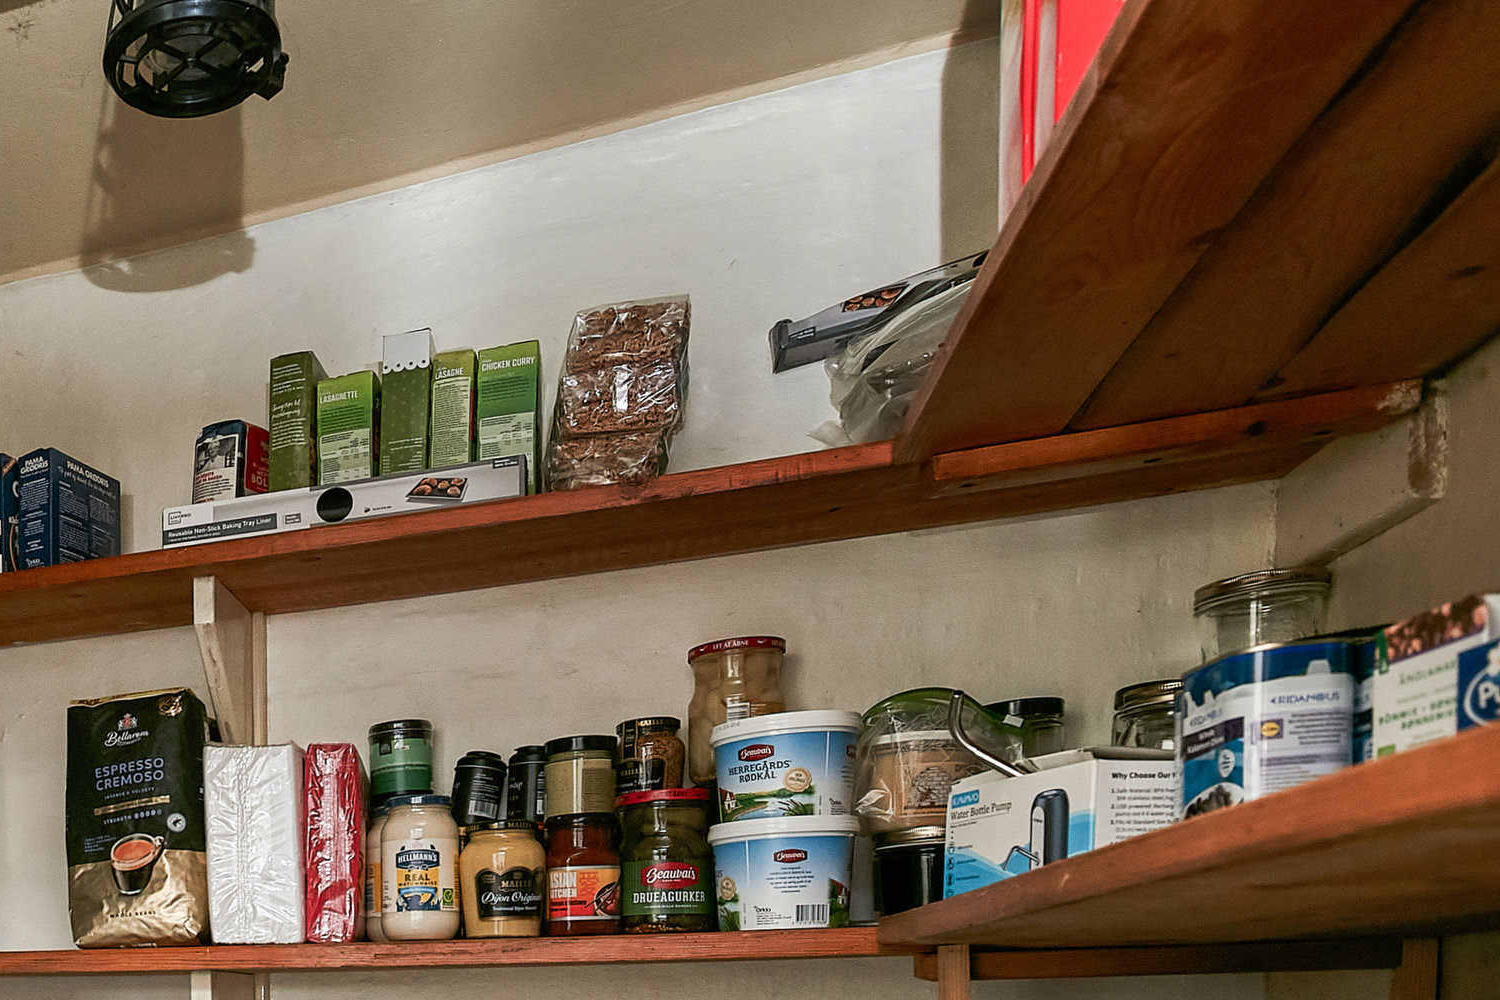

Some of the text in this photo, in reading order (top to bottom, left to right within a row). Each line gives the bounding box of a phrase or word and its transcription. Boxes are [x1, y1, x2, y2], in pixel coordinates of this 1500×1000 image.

[481, 355, 536, 372] CHICKEN CURRY
[434, 367, 464, 380] LASAGNE
[319, 389, 359, 404] LASAGNETTE
[168, 530, 193, 539] Reusable
[222, 521, 242, 530] Baking
[243, 519, 255, 528] Tray
[94, 757, 165, 780] ESPRESSO
[728, 759, 791, 777] HERREGÅRDS
[1111, 771, 1171, 780] Why Choose Our
[95, 769, 165, 792] CREMOSO
[738, 769, 777, 785] RØDKÅL
[950, 801, 1013, 821] Water Bottle Pump
[397, 852, 438, 864] HELLMANN'S
[404, 873, 431, 882] REAL
[645, 866, 697, 884] Beauvais
[481, 891, 510, 905] Dijon
[632, 890, 706, 904] DRUEAGURKER
